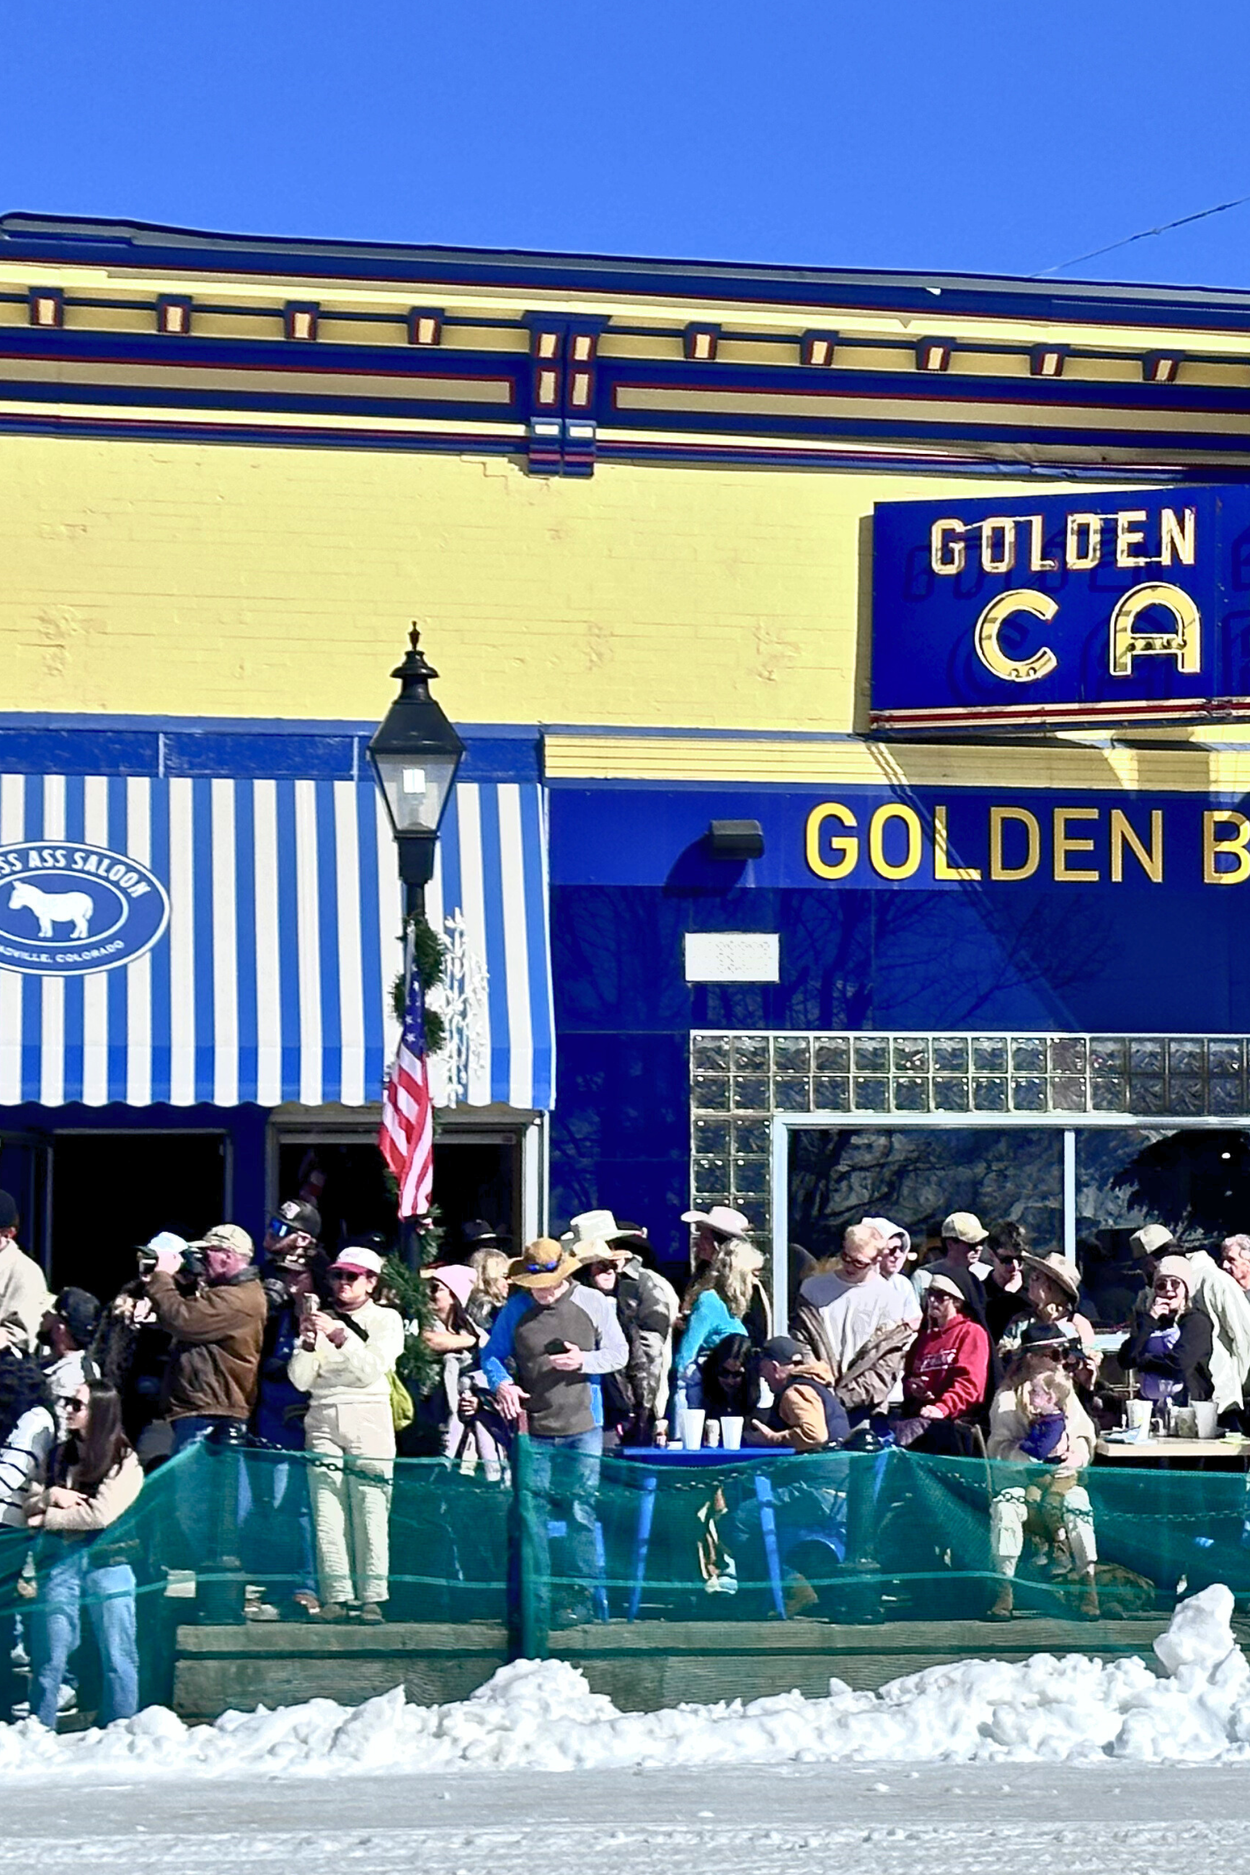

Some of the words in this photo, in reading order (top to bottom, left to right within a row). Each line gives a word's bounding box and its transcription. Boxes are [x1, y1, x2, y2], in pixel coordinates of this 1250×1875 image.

[931, 507, 1196, 575] GOLDEN
[805, 802, 1163, 883] GOLDEN
[28, 849, 67, 868] ASS
[71, 851, 152, 898] SALOON
[55, 940, 125, 962] COLORADO
